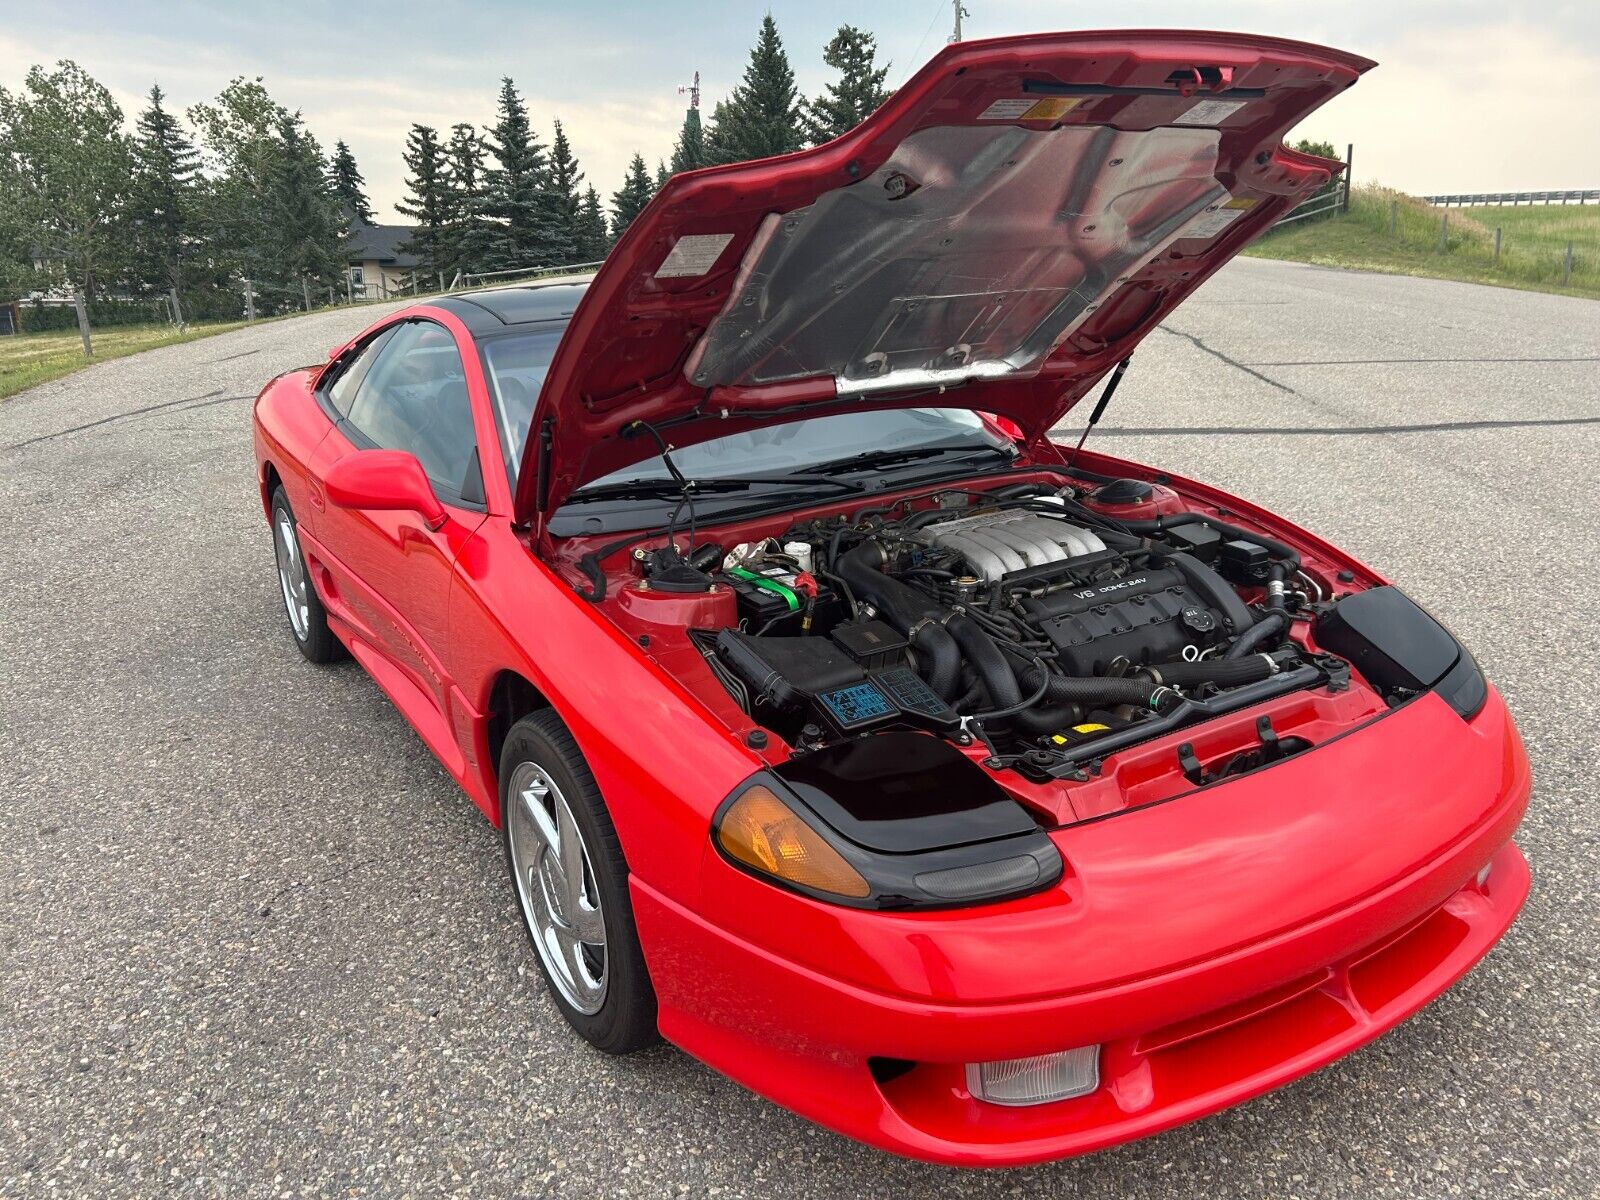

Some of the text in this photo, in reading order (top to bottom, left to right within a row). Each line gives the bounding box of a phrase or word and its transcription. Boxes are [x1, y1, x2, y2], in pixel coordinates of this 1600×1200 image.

[1073, 577, 1147, 599] V6 DOHC 24V
